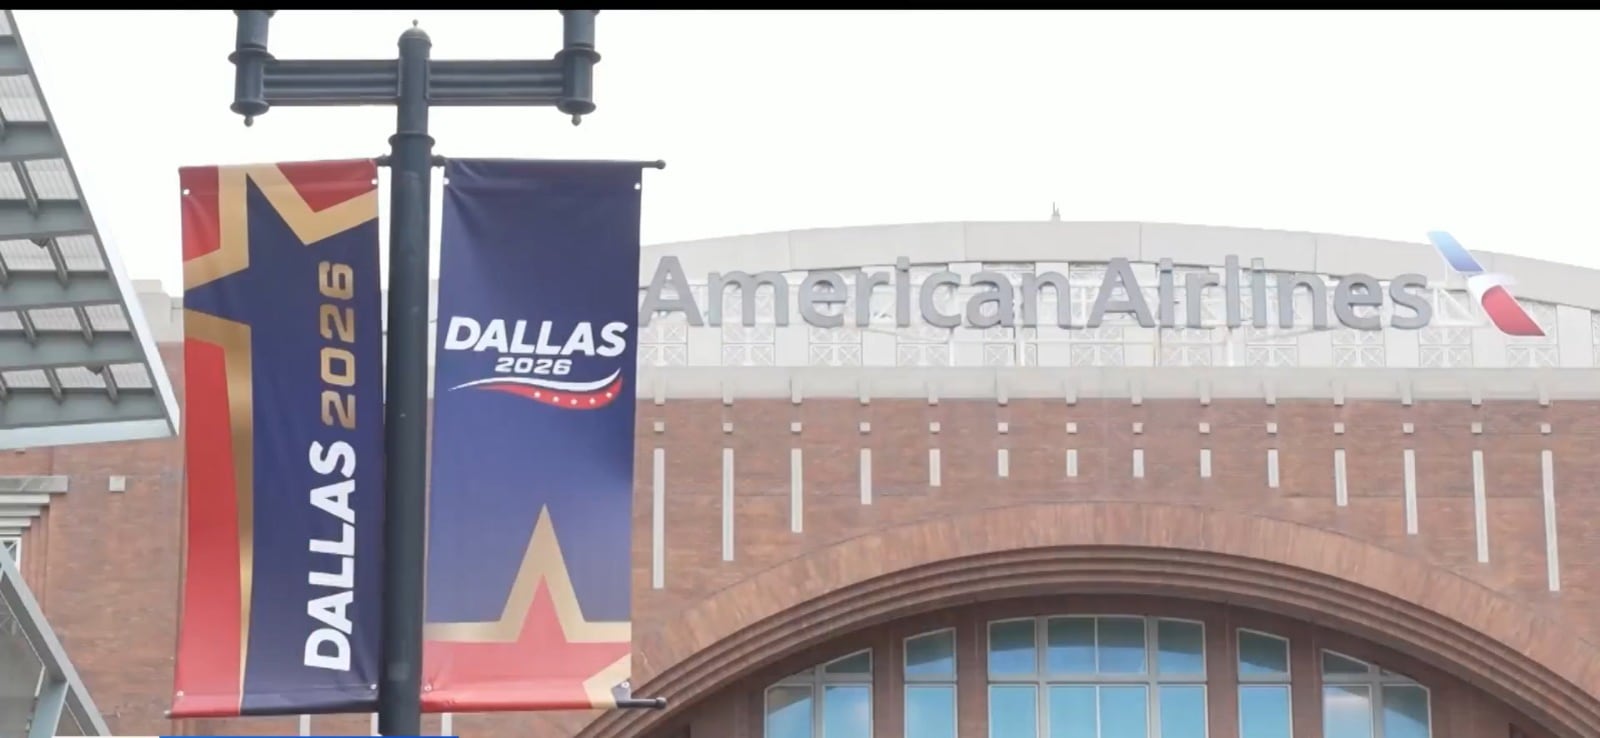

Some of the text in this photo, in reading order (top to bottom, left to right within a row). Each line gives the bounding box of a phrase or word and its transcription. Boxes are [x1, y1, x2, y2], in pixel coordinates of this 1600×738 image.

[444, 316, 628, 357] DALLAS
[494, 357, 573, 376] 2026
[304, 260, 357, 672] DALLAS 2026
